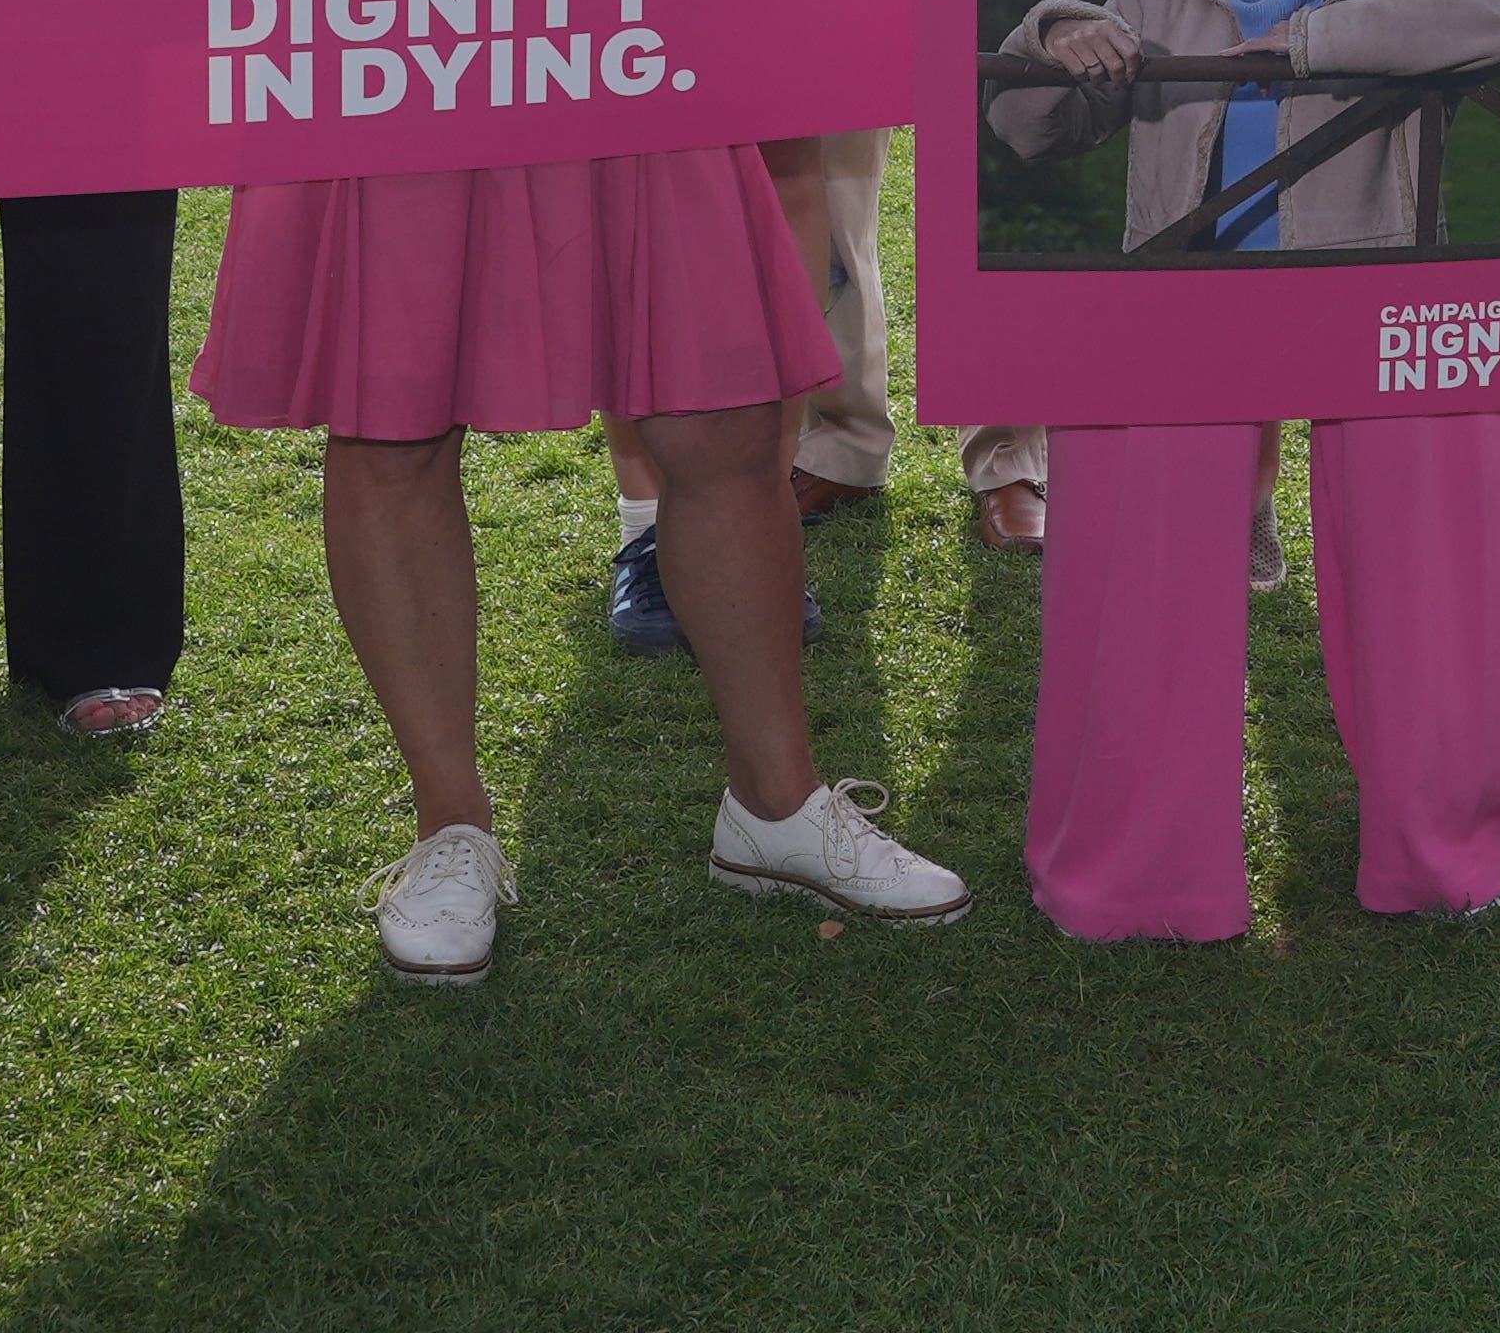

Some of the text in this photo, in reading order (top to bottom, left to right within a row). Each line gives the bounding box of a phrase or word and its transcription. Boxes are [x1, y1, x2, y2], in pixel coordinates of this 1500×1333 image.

[209, 28, 695, 124] IN DYING.
[1379, 360, 1426, 391] IN
